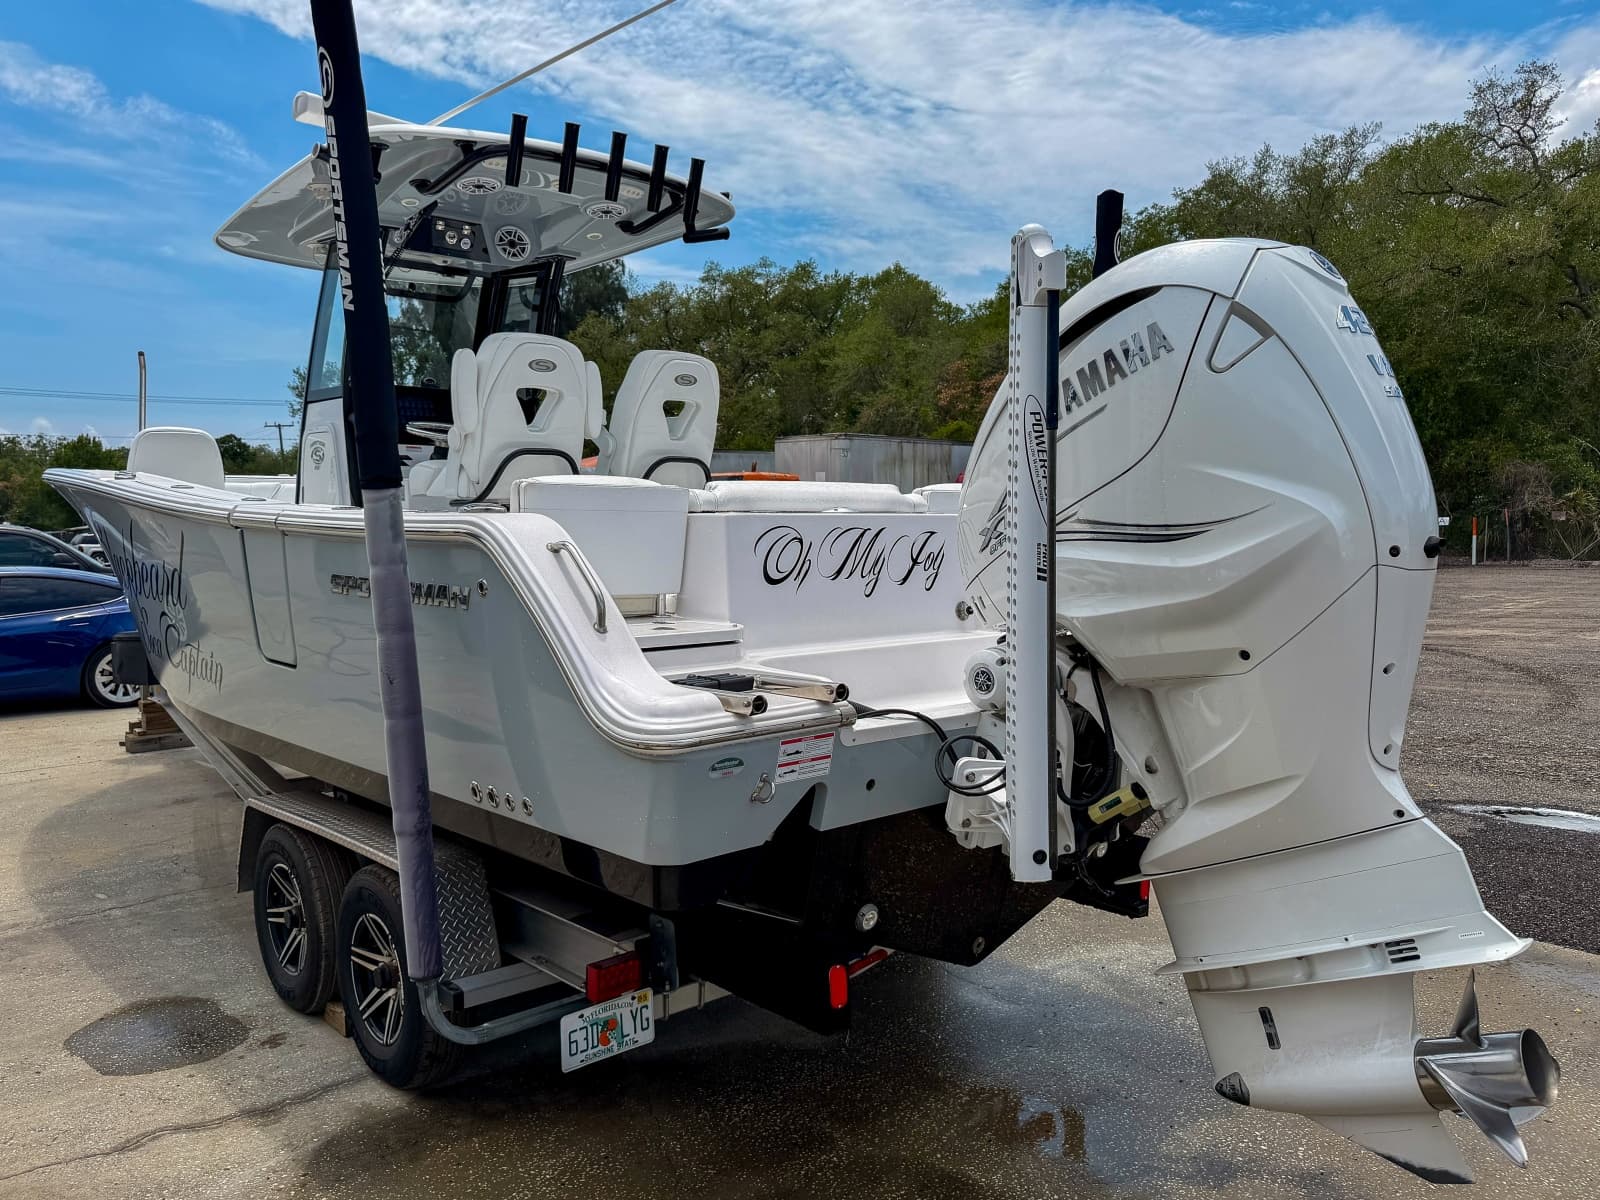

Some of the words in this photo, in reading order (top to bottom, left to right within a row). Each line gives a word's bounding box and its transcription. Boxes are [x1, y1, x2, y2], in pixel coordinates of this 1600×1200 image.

[326, 115, 355, 312] SPORTSMAN
[1336, 304, 1376, 338] 42
[1059, 321, 1175, 420] AMAHA
[1029, 411, 1048, 507] POWER-
[330, 573, 471, 611] SPOMAN
[754, 525, 812, 595] Oh
[817, 526, 887, 598] My
[887, 530, 946, 592] Joy
[159, 611, 224, 694] Captain
[568, 1022, 600, 1057] 63D
[620, 1004, 650, 1039] LYG
[584, 1045, 615, 1062] SUNSHINE
